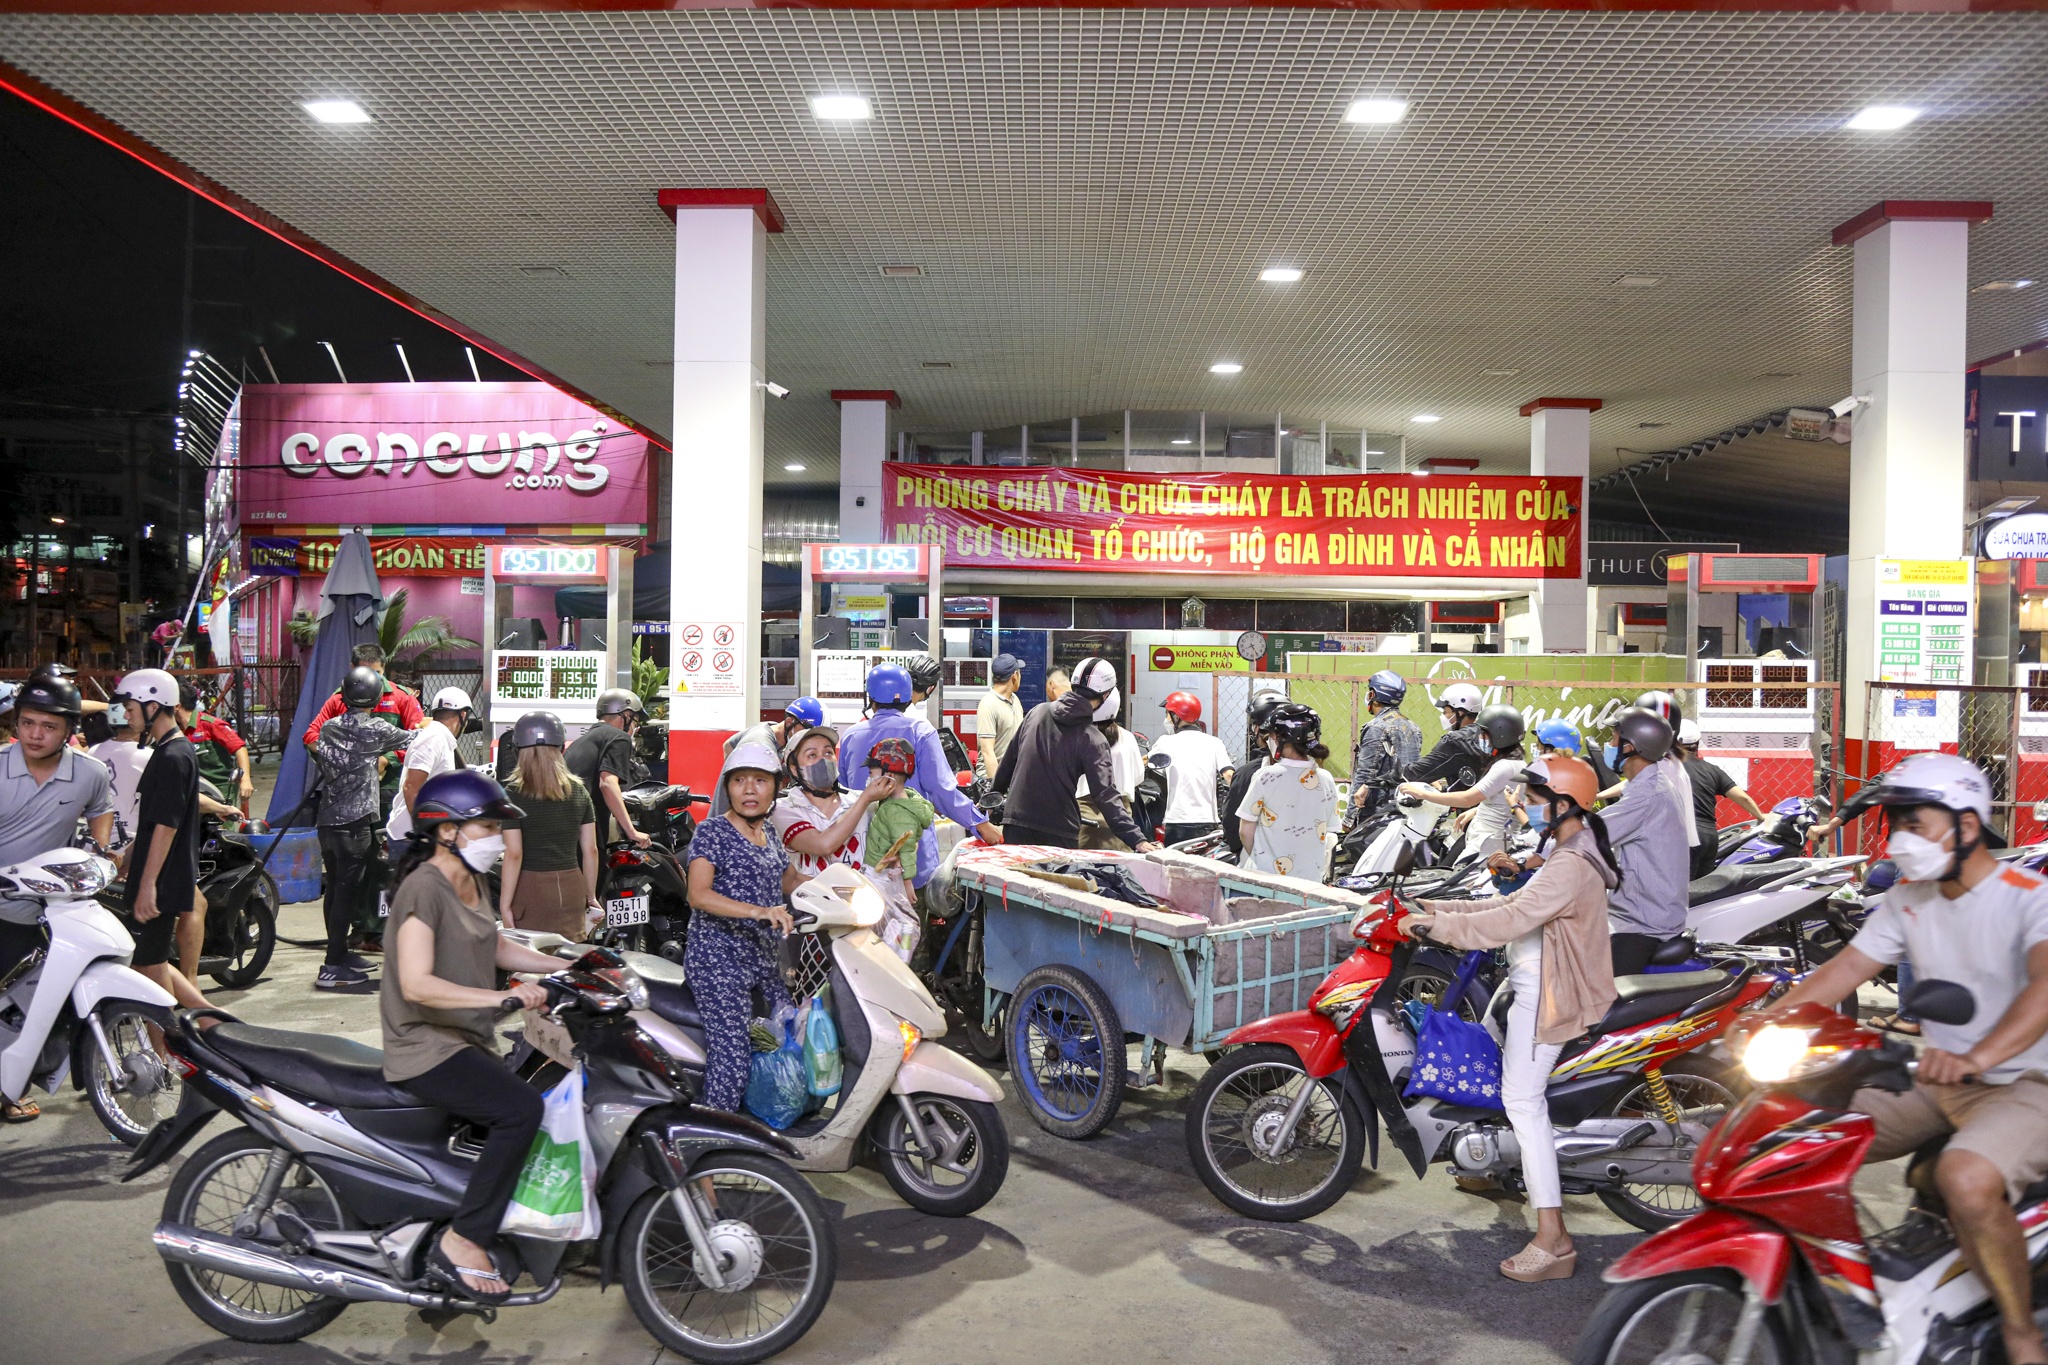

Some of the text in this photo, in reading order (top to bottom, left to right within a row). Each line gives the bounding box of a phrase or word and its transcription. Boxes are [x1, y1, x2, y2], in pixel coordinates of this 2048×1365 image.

[1999, 411, 2048, 452] T
[896, 470, 1569, 527] PHÒNG CHÁY VÀ CHỮA CHÁY LÀ TRÁCH NHIỆM CỦA
[956, 522, 994, 557] CƠ
[1001, 526, 1082, 565] QUAN,
[1091, 517, 1124, 561] TỔ
[1131, 524, 1213, 566] CHỨC,
[1229, 525, 1266, 571] HỘ
[1275, 534, 1320, 566] GIA
[1328, 526, 1394, 566] ĐÌNH
[1403, 528, 1437, 567] VÀ
[1445, 528, 1482, 567] CÁ
[1490, 530, 1566, 568] NHÂN
[303, 541, 341, 572] 10
[377, 544, 444, 569] HOÀN
[509, 550, 541, 572] 95
[828, 549, 910, 570] 95 95
[1931, 626, 1960, 635] 21440
[1930, 640, 1959, 649] 20730
[1175, 649, 1208, 659] KHÔNG
[1210, 650, 1235, 660] PHẬN
[1214, 658, 1233, 669] VÀO
[608, 910, 647, 926] 899.98
[1381, 1049, 1414, 1058] HONDA
